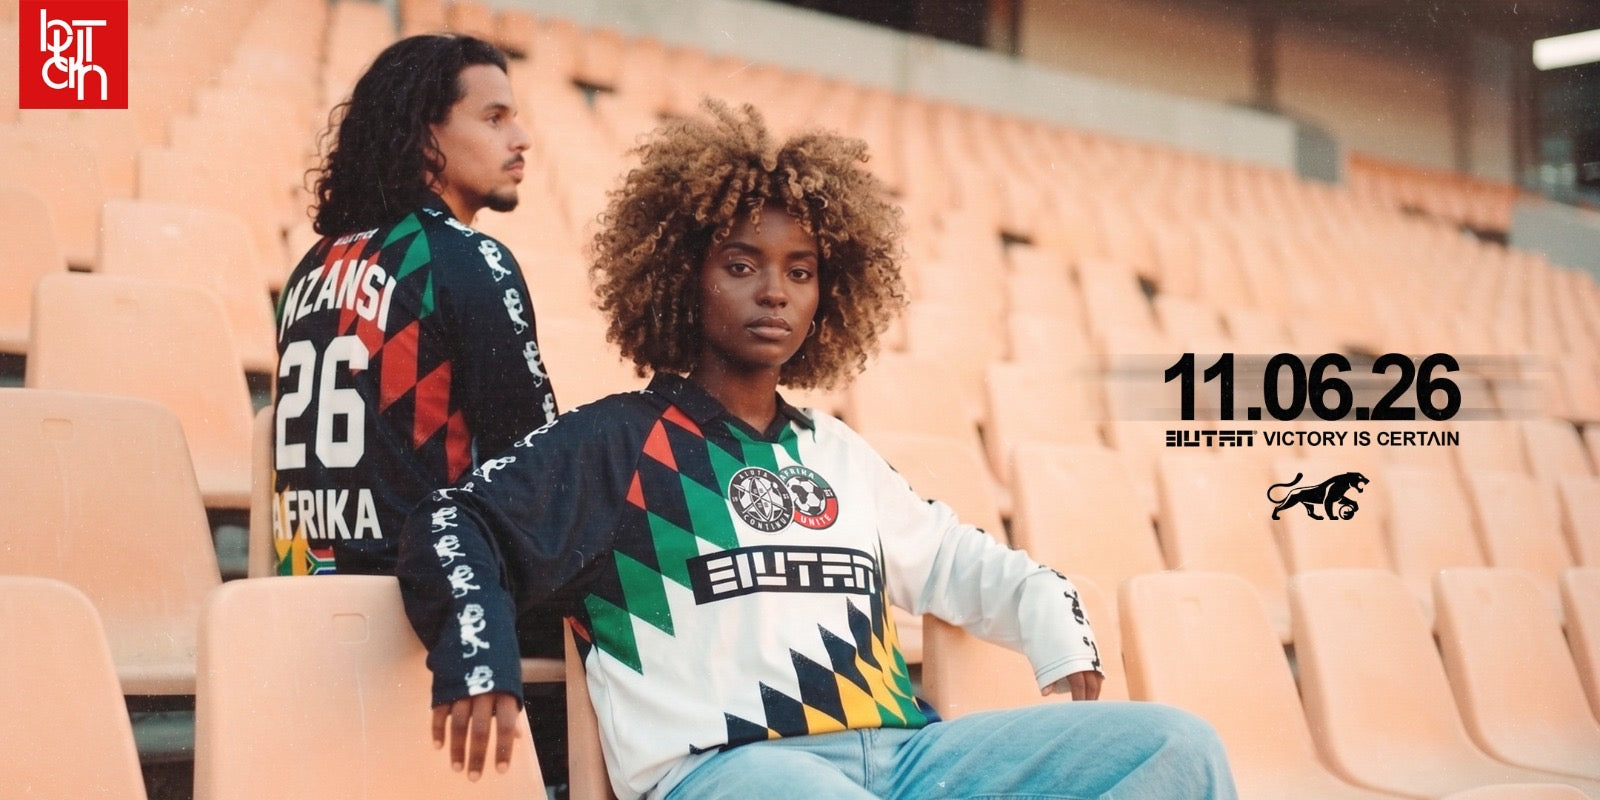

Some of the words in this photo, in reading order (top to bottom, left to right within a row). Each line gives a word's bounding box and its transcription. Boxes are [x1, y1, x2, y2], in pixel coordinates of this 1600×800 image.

[279, 259, 397, 343] MZANSI
[275, 334, 370, 470] 26
[780, 468, 815, 481] AFRIKA
[272, 488, 384, 540] AFRIKA
[743, 512, 791, 531] CONTINUA
